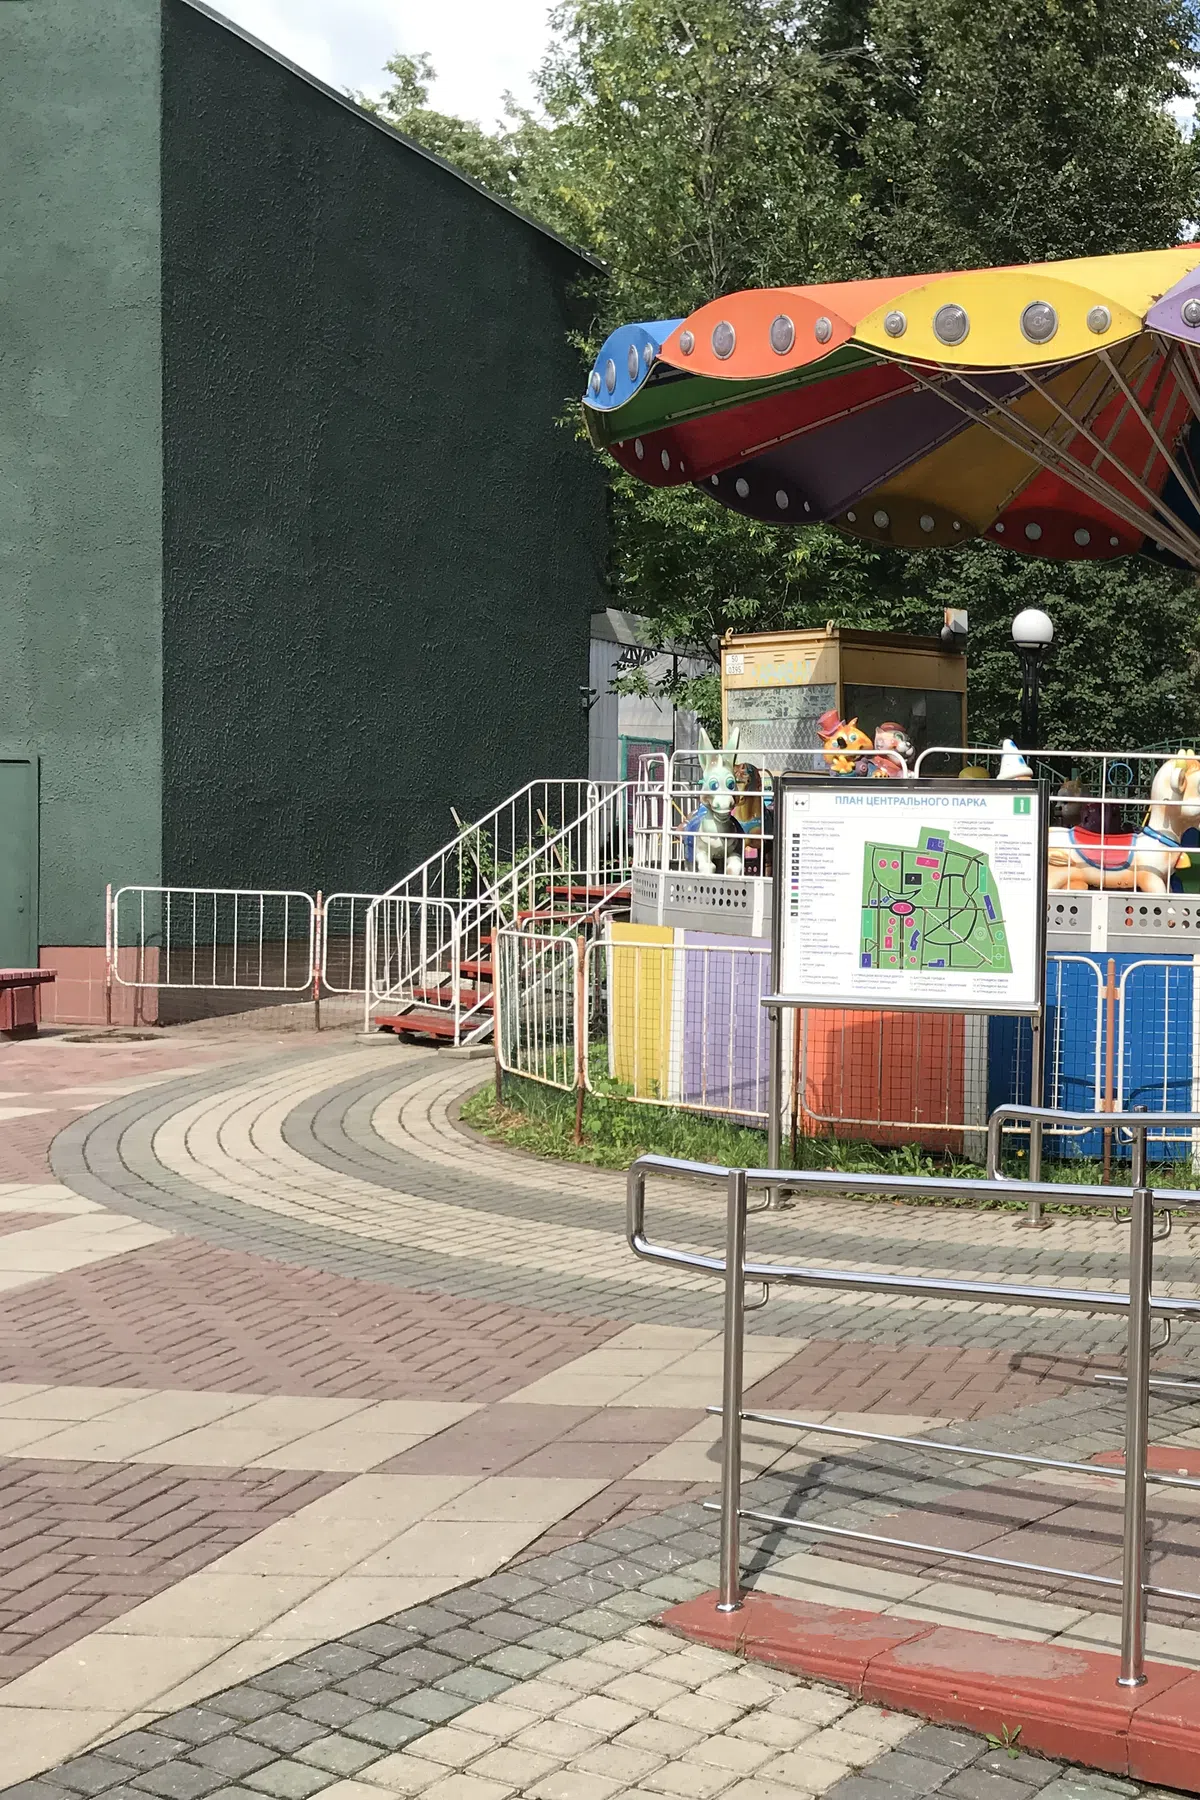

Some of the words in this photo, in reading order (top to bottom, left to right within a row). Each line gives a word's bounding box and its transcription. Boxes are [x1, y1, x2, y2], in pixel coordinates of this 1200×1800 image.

[835, 795, 864, 805] ПЛАН
[866, 796, 950, 807] ЦЕНТРАЛЬНОГО
[952, 797, 988, 807] ПАРКА
